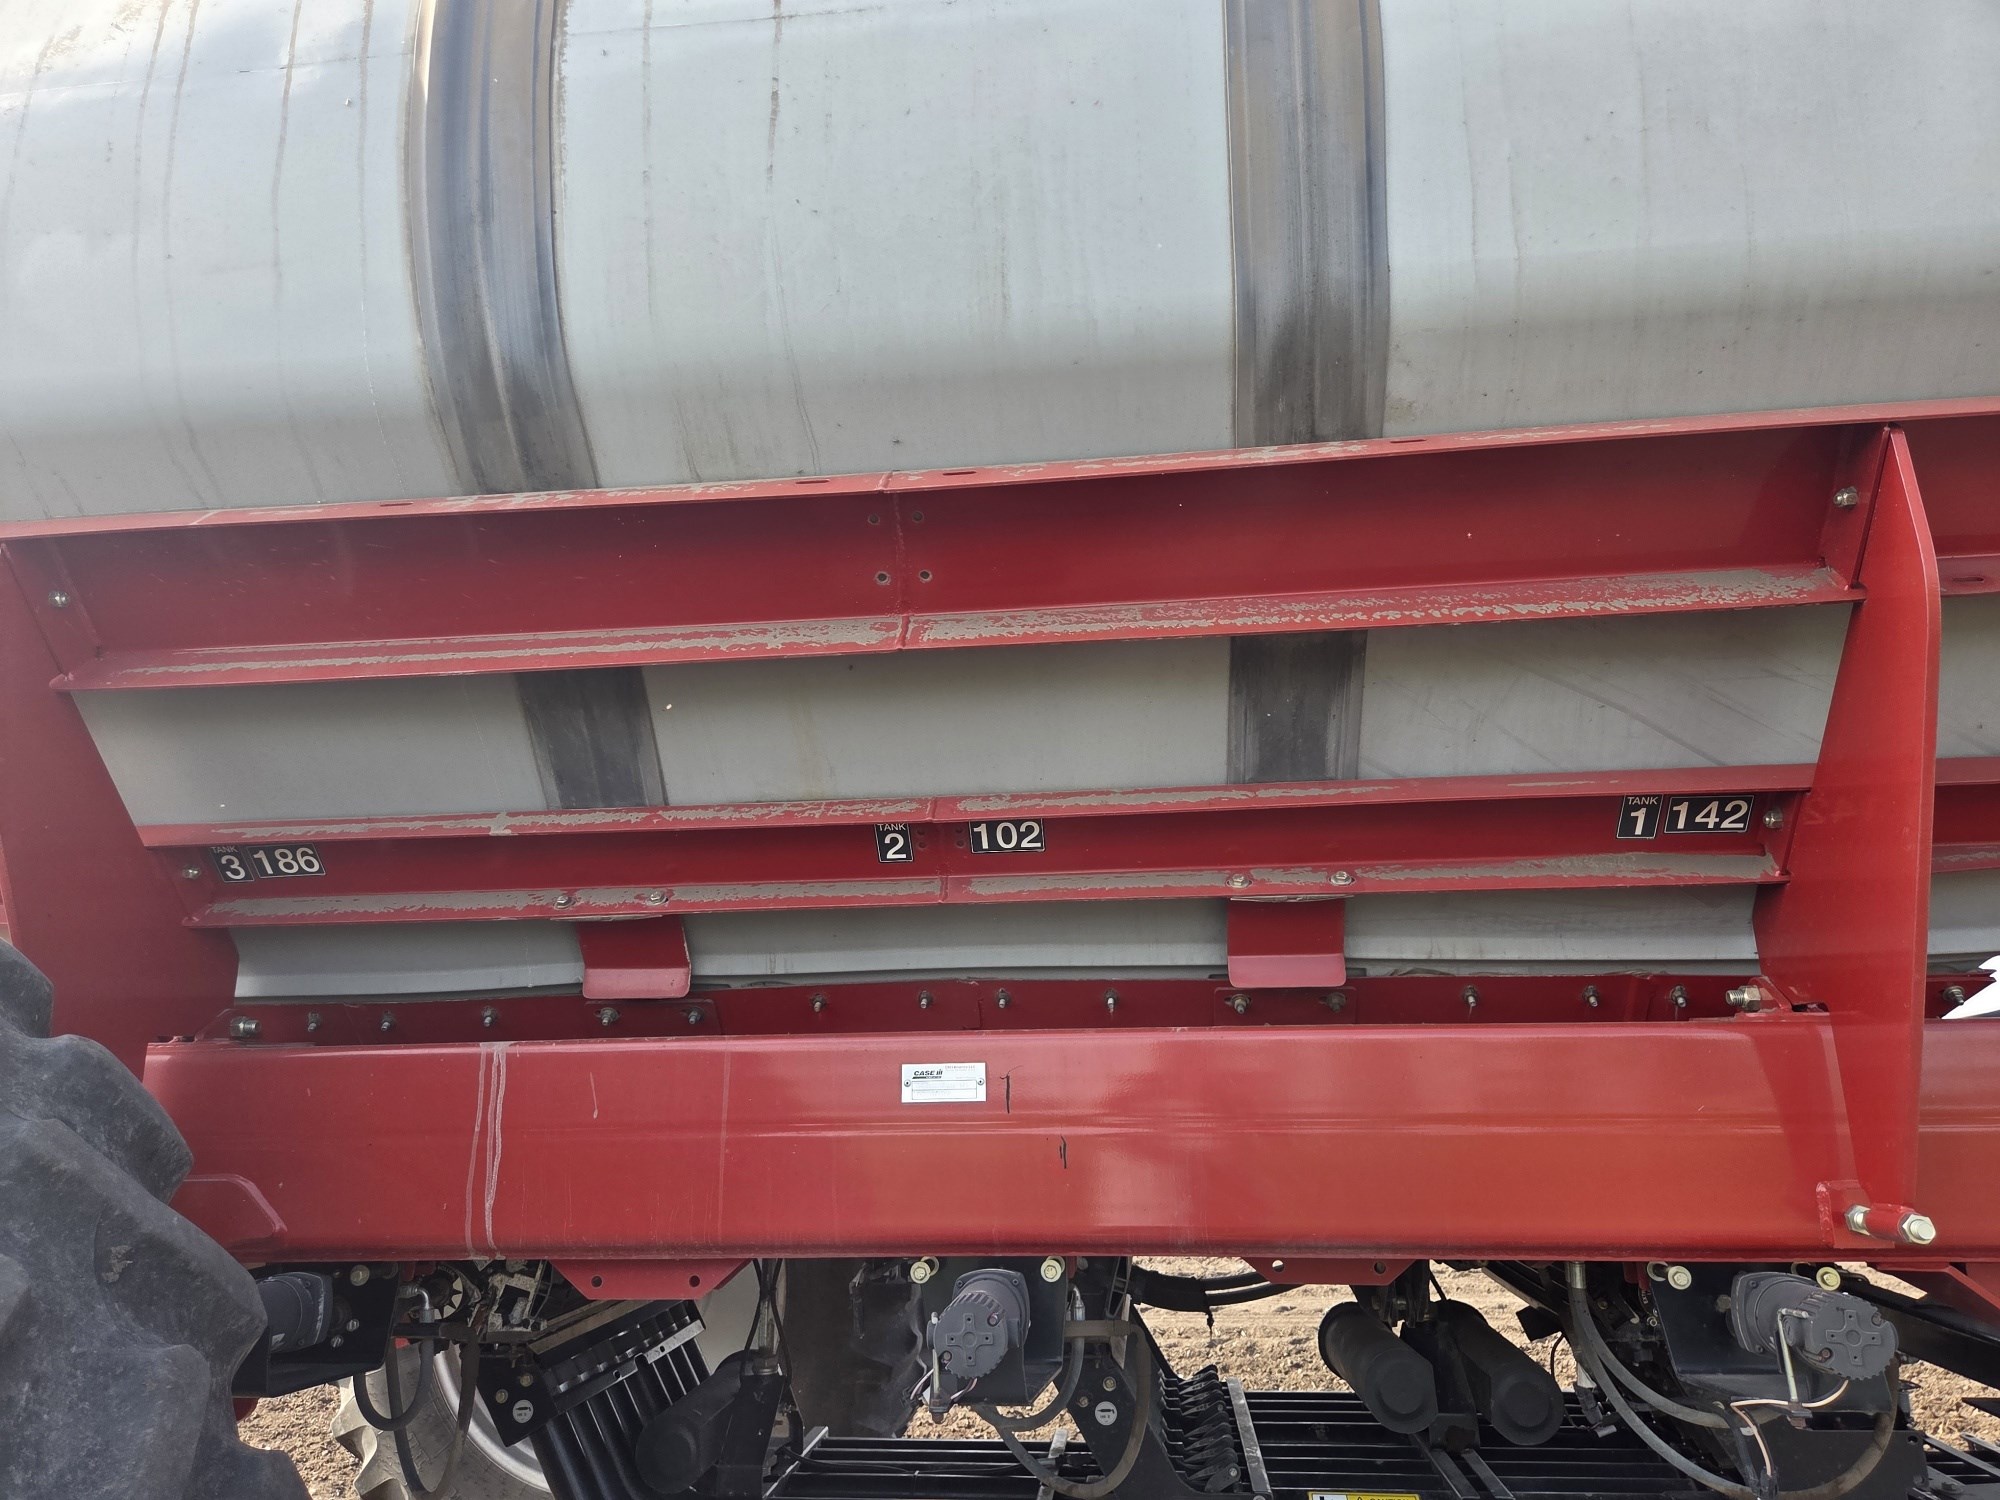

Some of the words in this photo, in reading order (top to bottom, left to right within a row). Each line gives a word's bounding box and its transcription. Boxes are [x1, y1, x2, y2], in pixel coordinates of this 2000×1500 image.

[1628, 796, 1659, 805] TANK
[877, 822, 906, 831] TANK
[1631, 808, 1647, 835] 1
[1672, 800, 1748, 829] 142
[884, 833, 907, 859] 2
[973, 821, 1042, 850] 102
[221, 855, 246, 880] 3
[253, 847, 320, 875] 186
